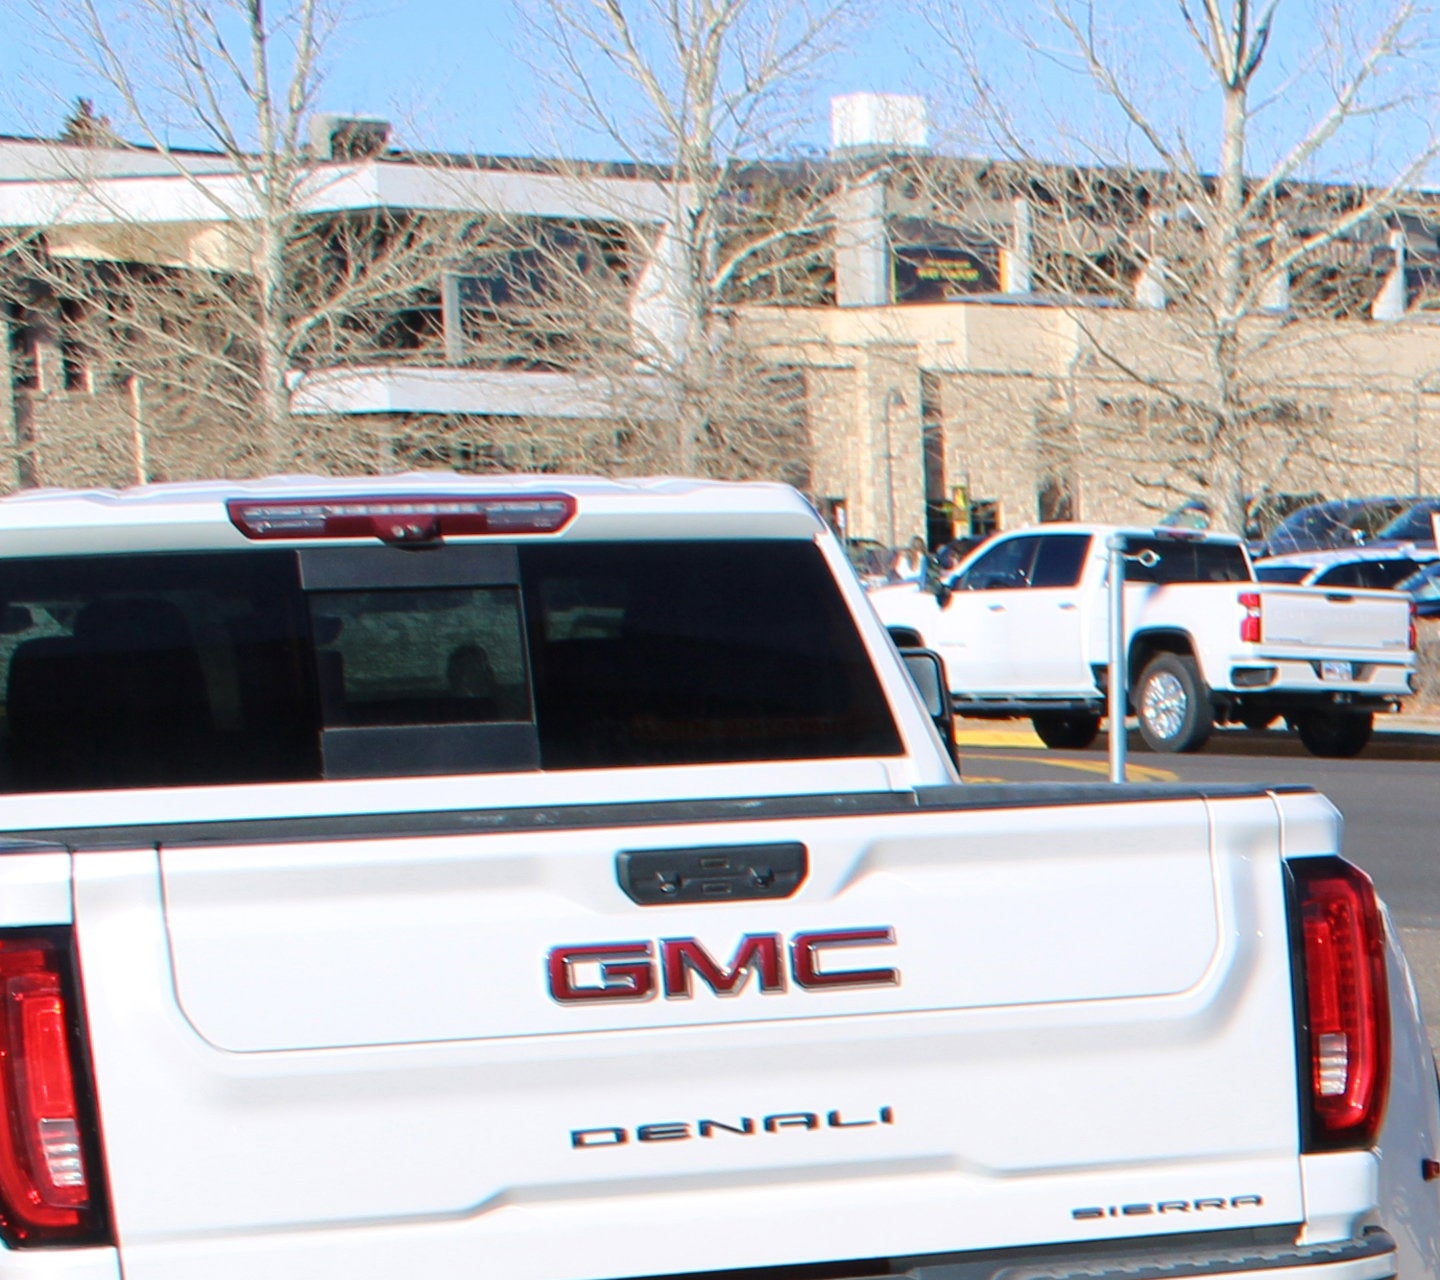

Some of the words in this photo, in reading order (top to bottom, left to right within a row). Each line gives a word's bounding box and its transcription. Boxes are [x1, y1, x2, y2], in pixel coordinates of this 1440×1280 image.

[545, 925, 900, 1005] GMC
[571, 1104, 894, 1150] DENALI
[1072, 1194, 1263, 1221] SIERRA
